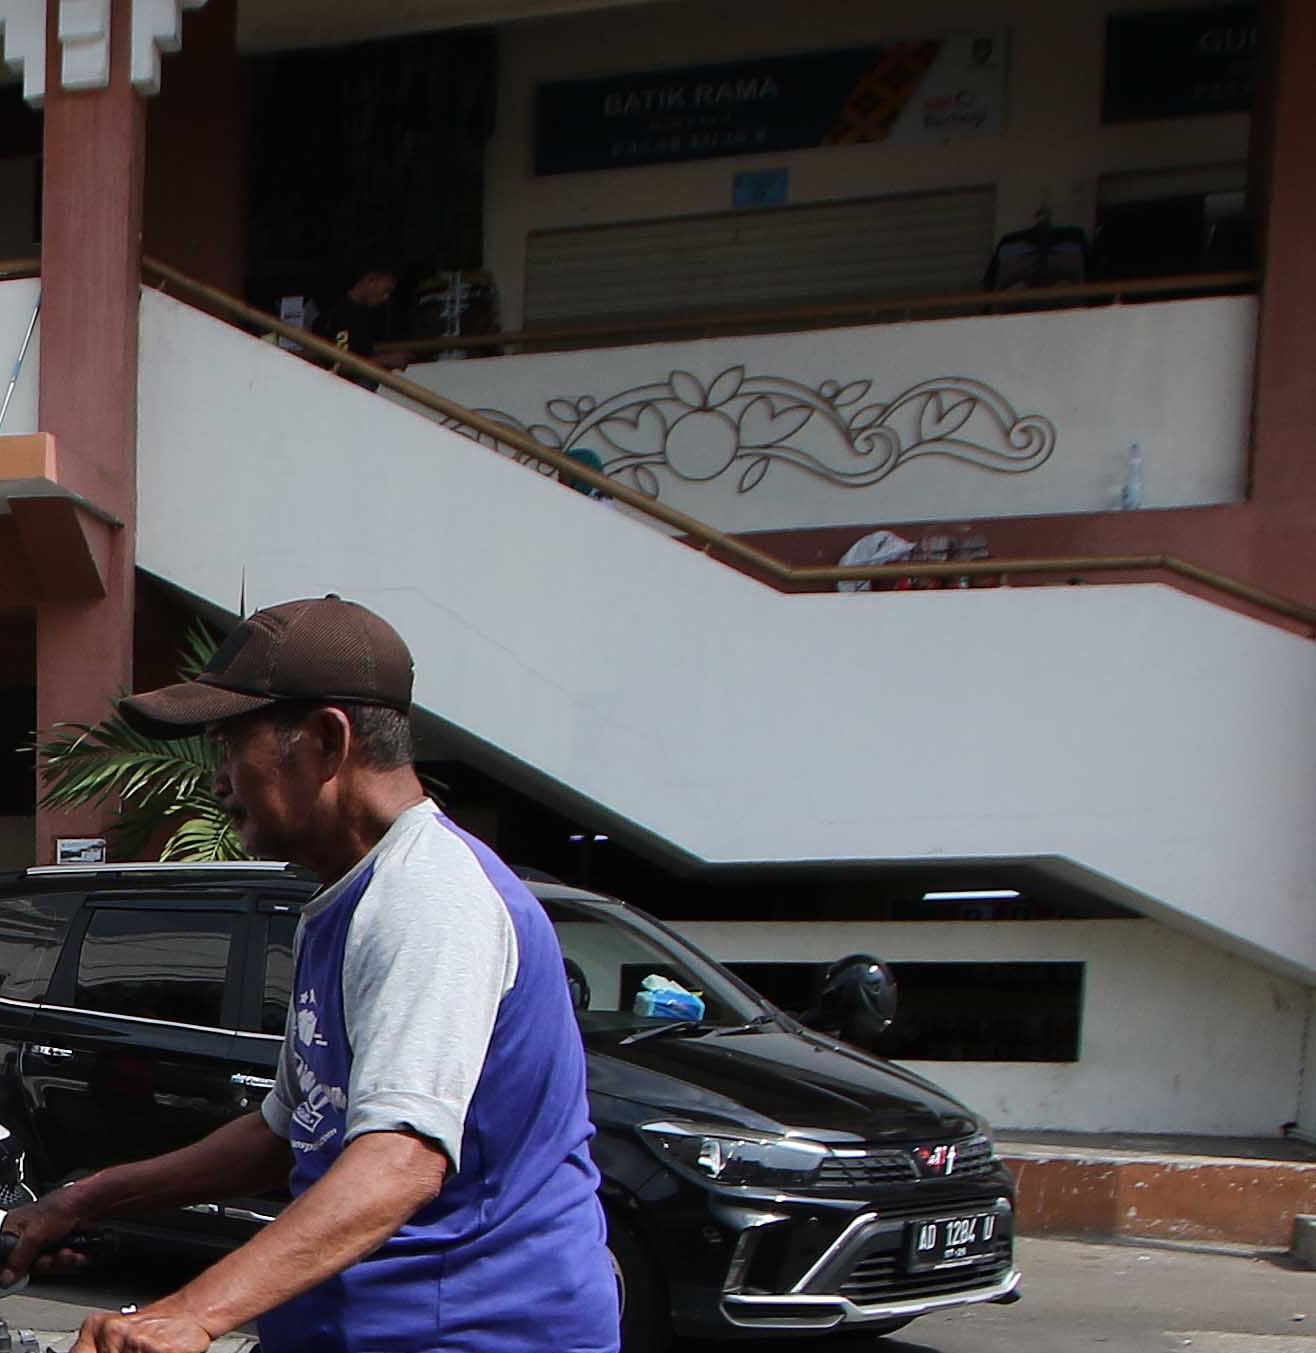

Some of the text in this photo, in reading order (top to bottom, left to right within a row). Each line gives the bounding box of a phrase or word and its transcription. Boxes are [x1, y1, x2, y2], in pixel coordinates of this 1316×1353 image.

[603, 74, 778, 118] BATIK RAMA
[918, 1224, 936, 1250] AD
